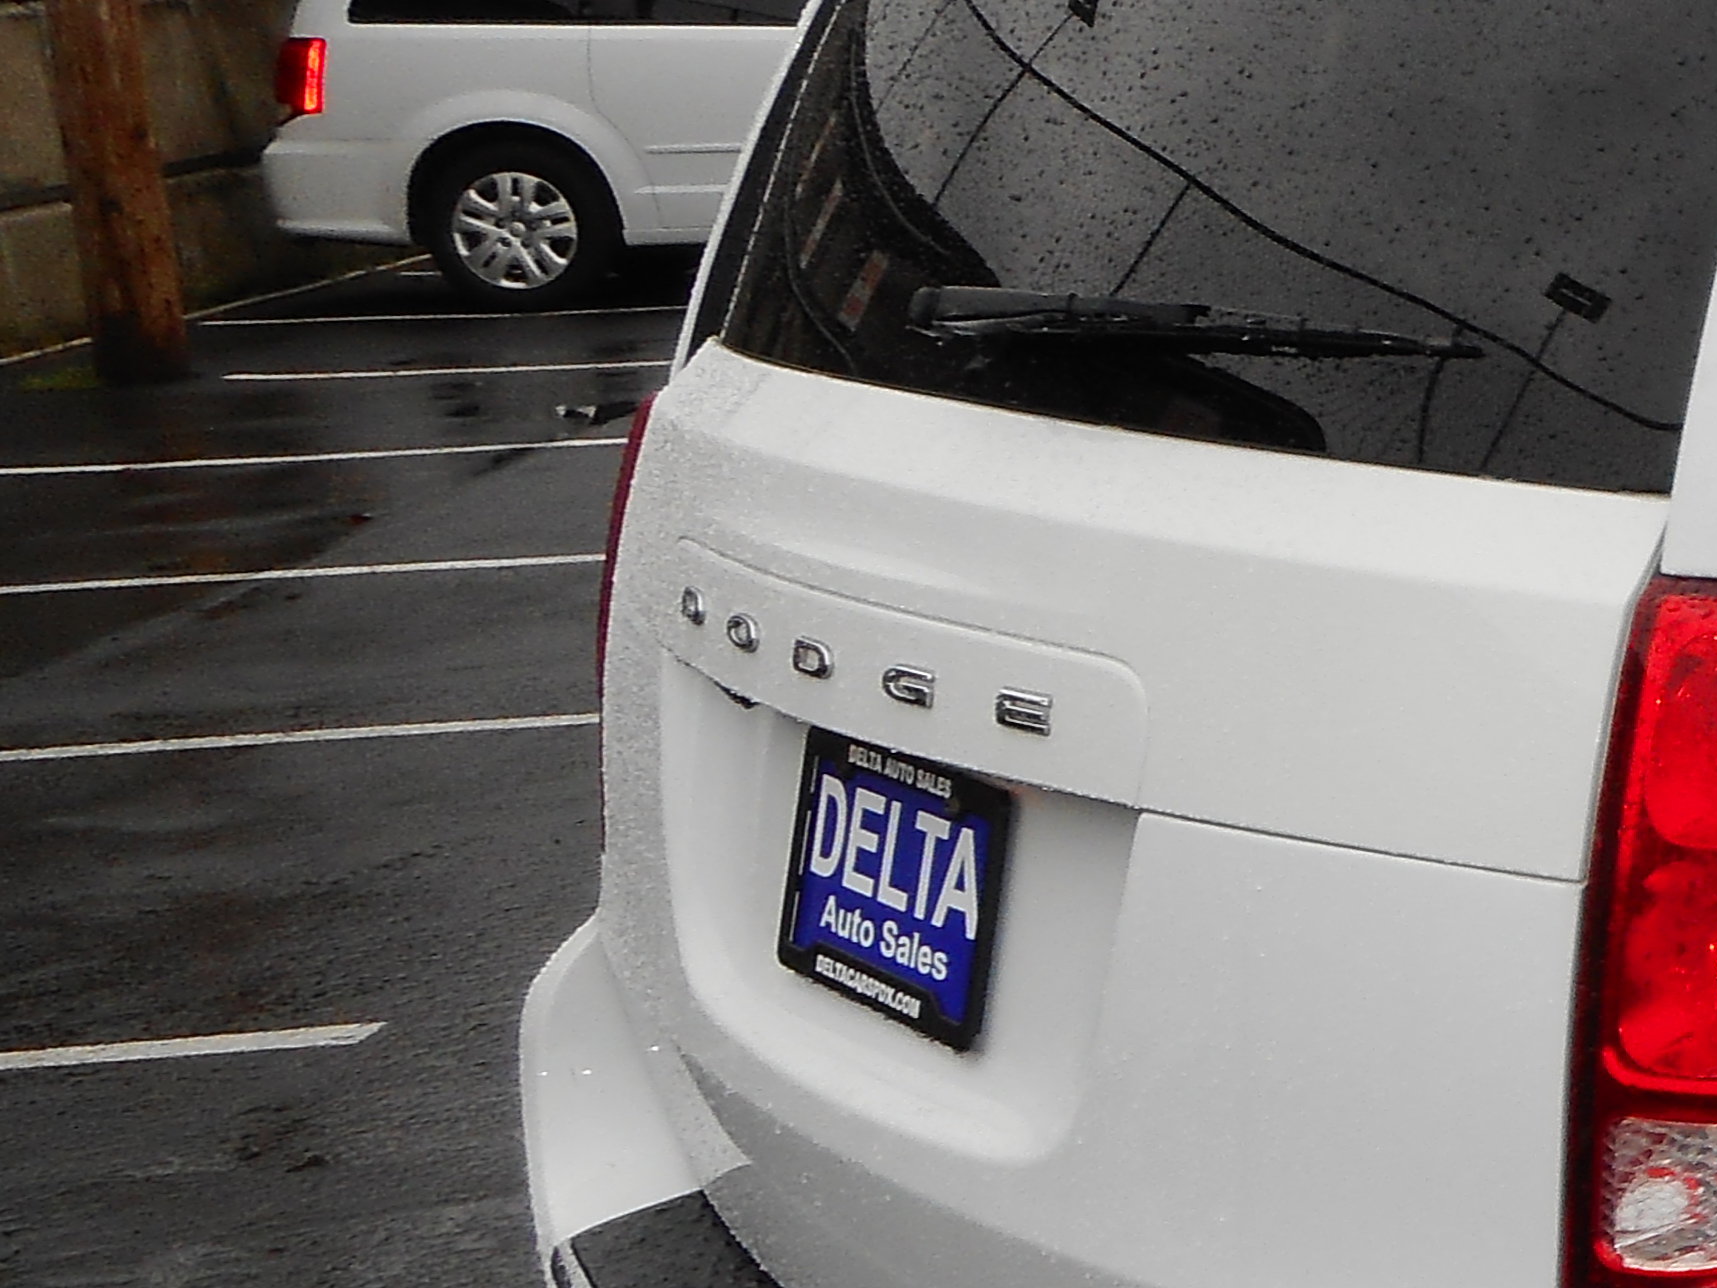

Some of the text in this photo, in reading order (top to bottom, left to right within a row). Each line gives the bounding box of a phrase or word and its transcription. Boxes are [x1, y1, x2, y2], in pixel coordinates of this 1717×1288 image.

[681, 585, 1053, 737] DODGE
[847, 743, 952, 799] DELTA AUTO SALES
[809, 773, 979, 941] DELTA
[818, 894, 948, 981] Auto Sales
